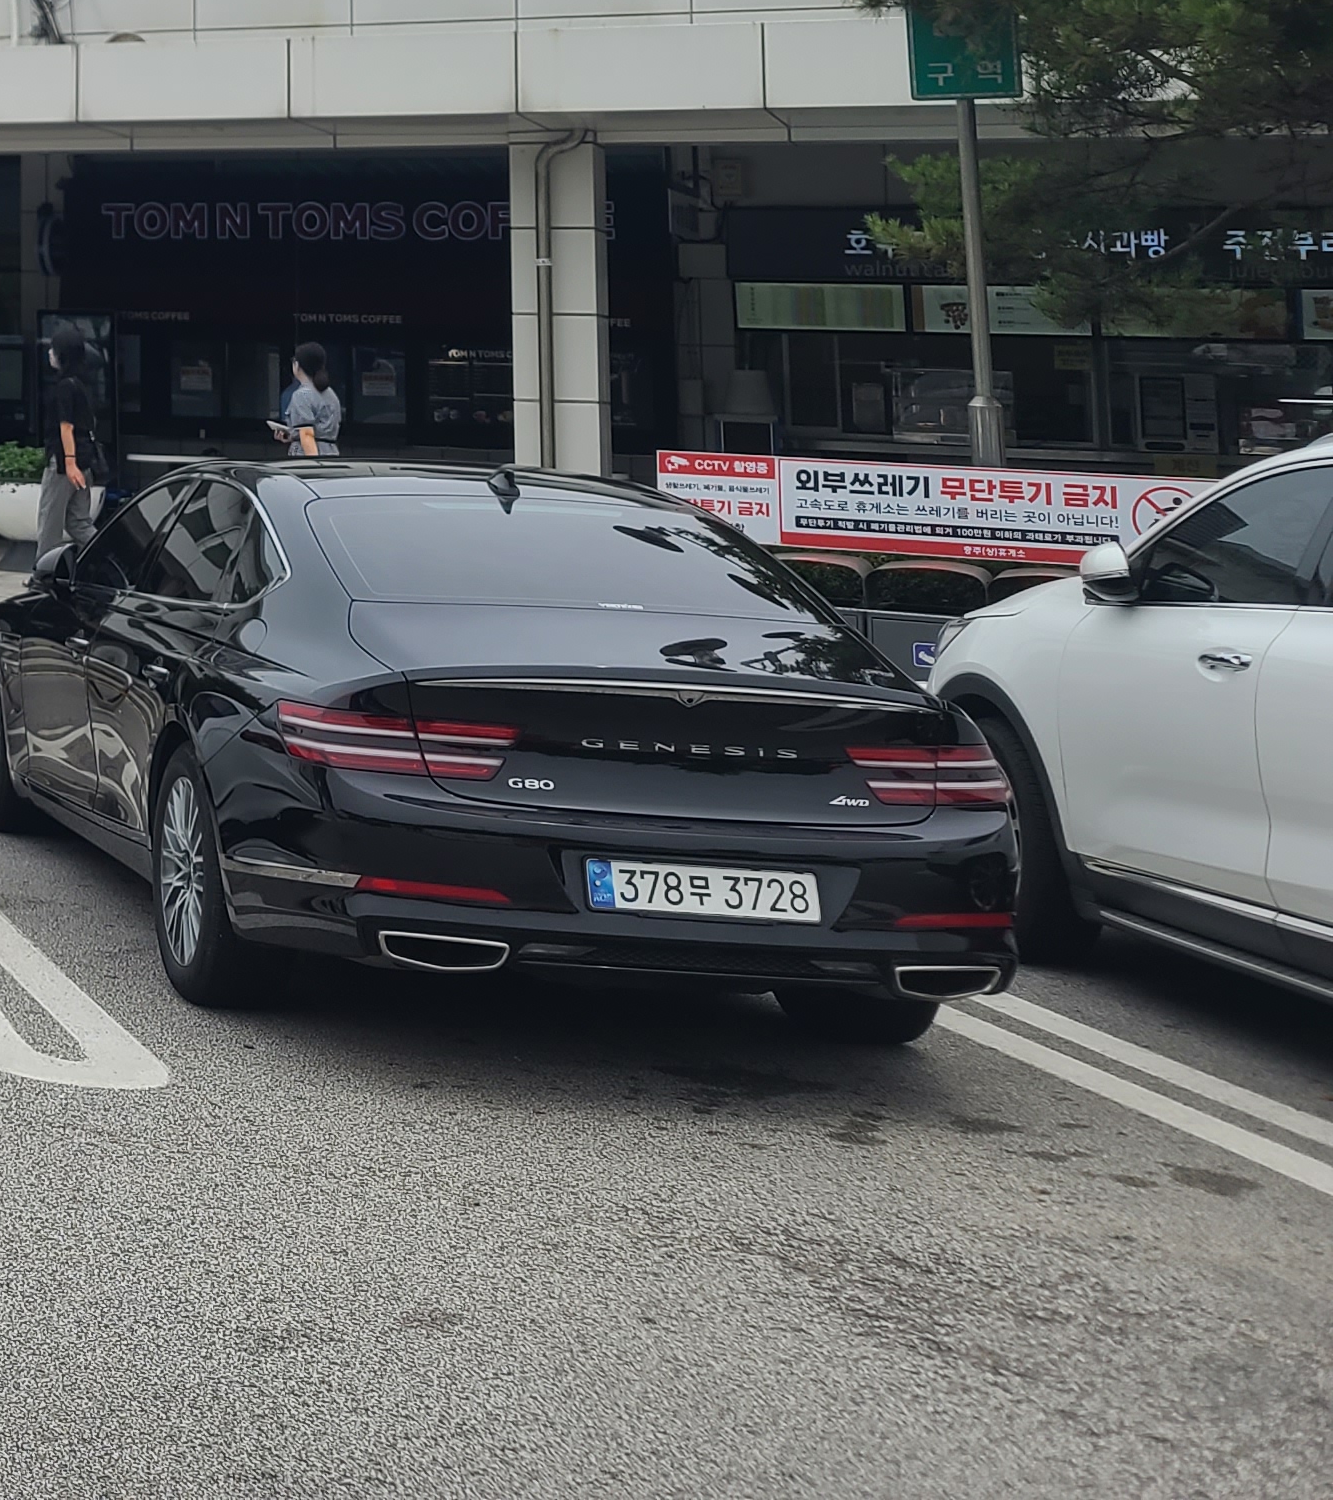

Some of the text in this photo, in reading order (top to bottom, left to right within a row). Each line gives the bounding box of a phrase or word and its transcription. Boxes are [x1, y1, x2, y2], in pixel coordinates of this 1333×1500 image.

[101, 202, 208, 239] TOM
[217, 202, 251, 239] N
[258, 202, 405, 240] TOMS
[150, 311, 190, 321] COFFEE
[293, 313, 403, 324] TOM N TOMS COFFEE
[694, 459, 730, 472] CCTV
[795, 469, 1118, 510] 외부쓰레기 무단투기 금지
[737, 501, 770, 518] 금지
[796, 498, 1120, 529] 고속도로 휴게소는 쓰레기를 버리는 곳이 아닙니다!
[799, 518, 834, 528] 무단투기
[858, 521, 867, 530] 시
[935, 526, 953, 536] 의거
[956, 528, 992, 538] 100만원
[995, 531, 1022, 540] 이하의
[580, 737, 799, 760] GENESIS
[507, 776, 555, 791] G80
[829, 795, 870, 807] 4WD
[617, 868, 810, 914] 378무 3728
